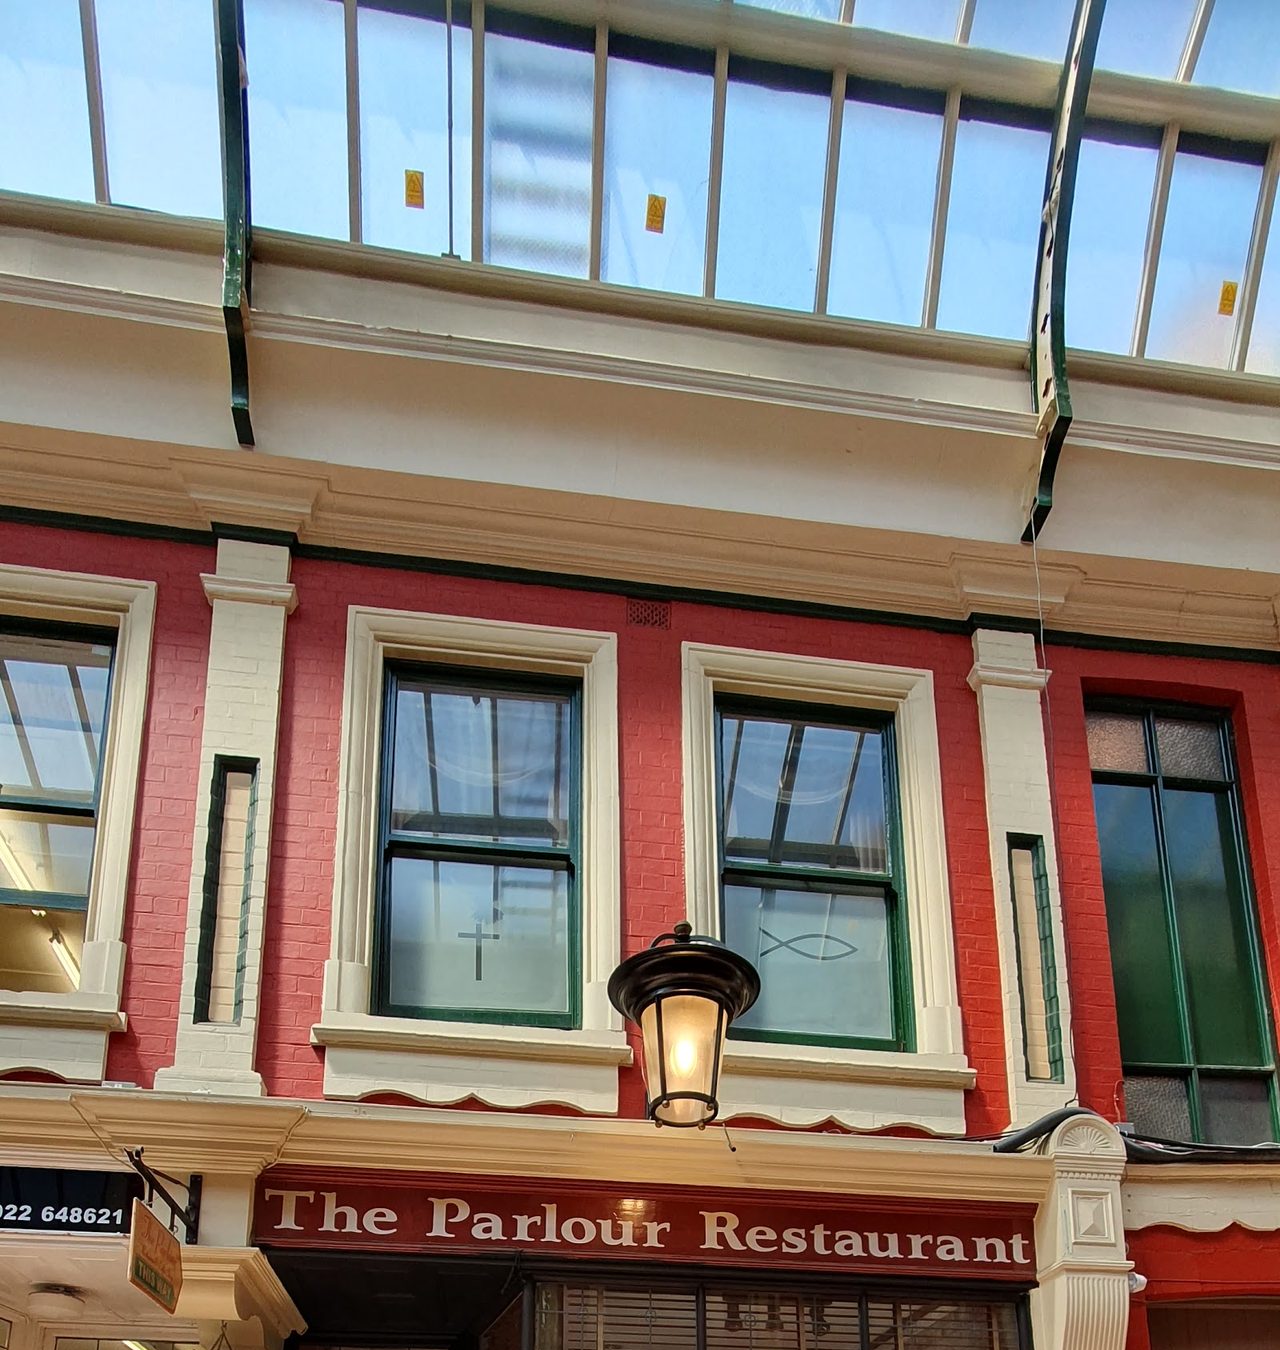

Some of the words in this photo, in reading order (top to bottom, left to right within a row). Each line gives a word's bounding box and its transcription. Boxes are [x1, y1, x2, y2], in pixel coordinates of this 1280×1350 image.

[0, 1204, 32, 1221] 22
[41, 1206, 123, 1224] 648621
[264, 1188, 398, 1235] The
[427, 1197, 671, 1248] Parlour
[699, 1210, 1031, 1265] Restaurant
